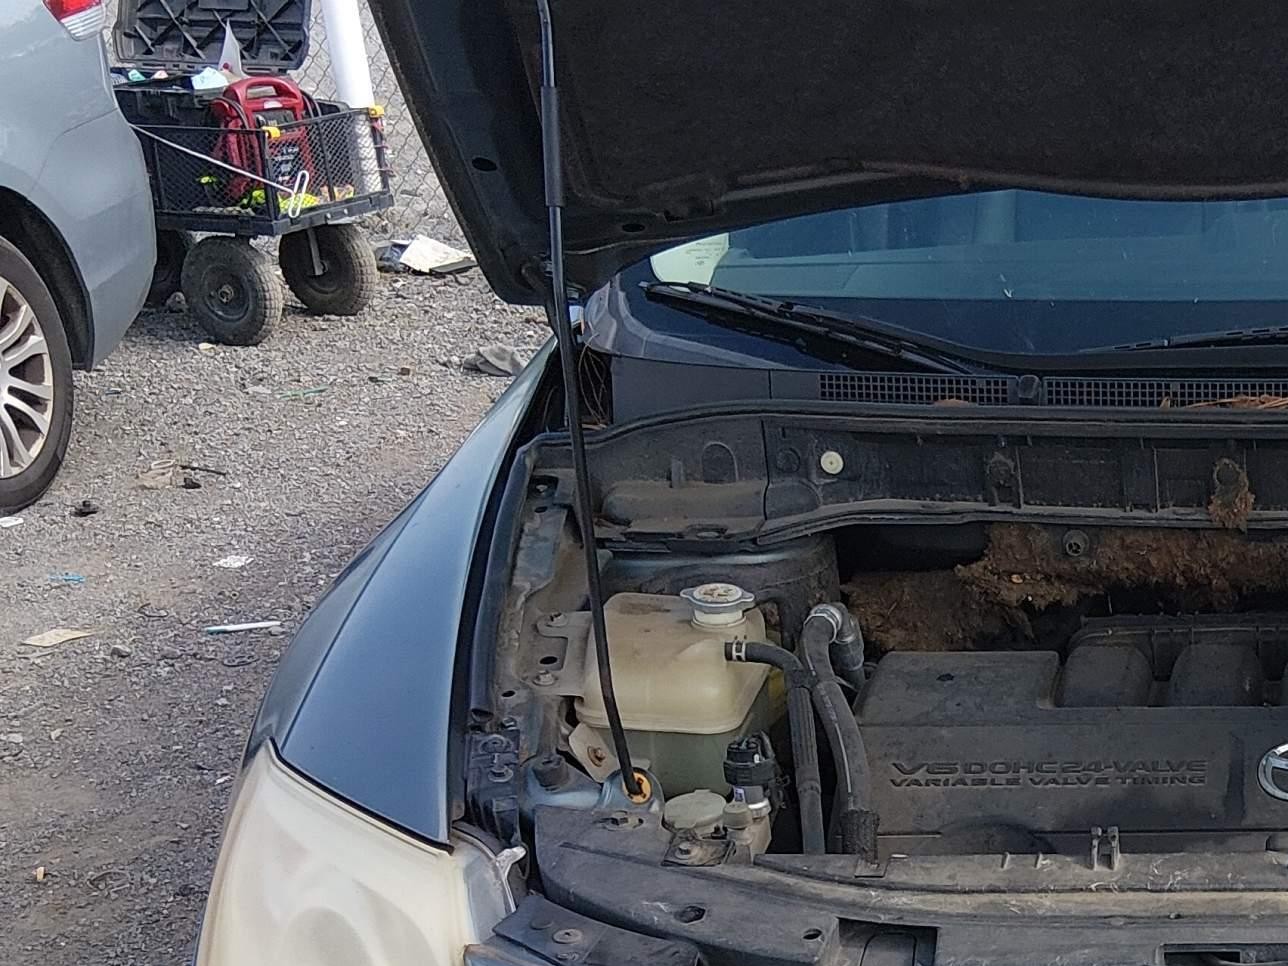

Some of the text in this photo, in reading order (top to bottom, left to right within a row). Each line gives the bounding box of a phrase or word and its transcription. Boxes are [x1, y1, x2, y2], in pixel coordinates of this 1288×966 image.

[889, 775, 1207, 788] VARIABLE VALVE TIMING
